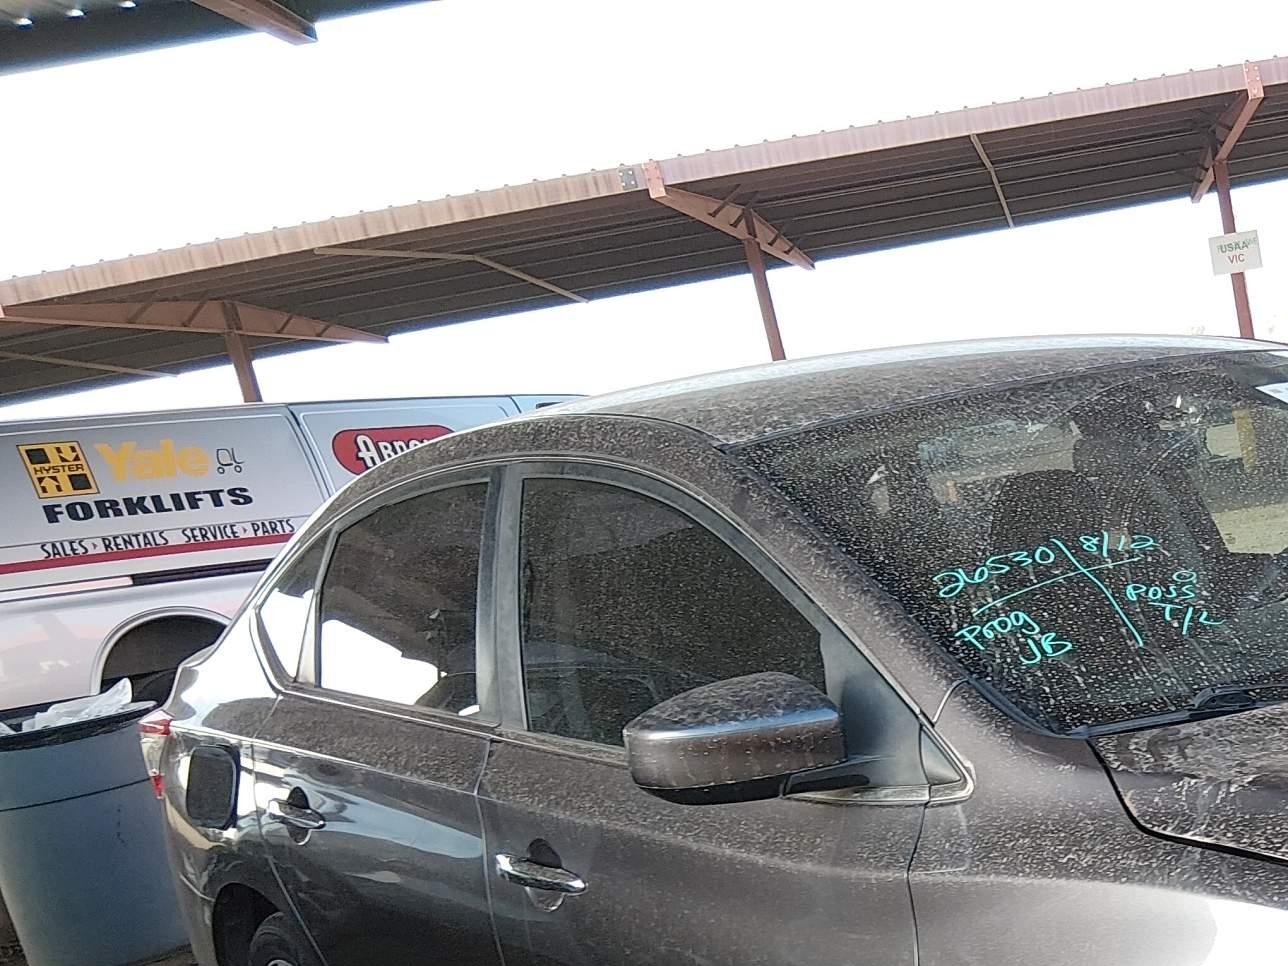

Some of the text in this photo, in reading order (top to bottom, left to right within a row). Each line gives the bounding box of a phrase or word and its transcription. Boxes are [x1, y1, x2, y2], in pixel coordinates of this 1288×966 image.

[1227, 252, 1246, 264] VIC
[33, 463, 85, 476] HYSTER
[95, 438, 211, 482] Yale
[42, 486, 254, 525] FORKLIFTS
[40, 518, 296, 560] SALES RENTALS SERVICE PARTS
